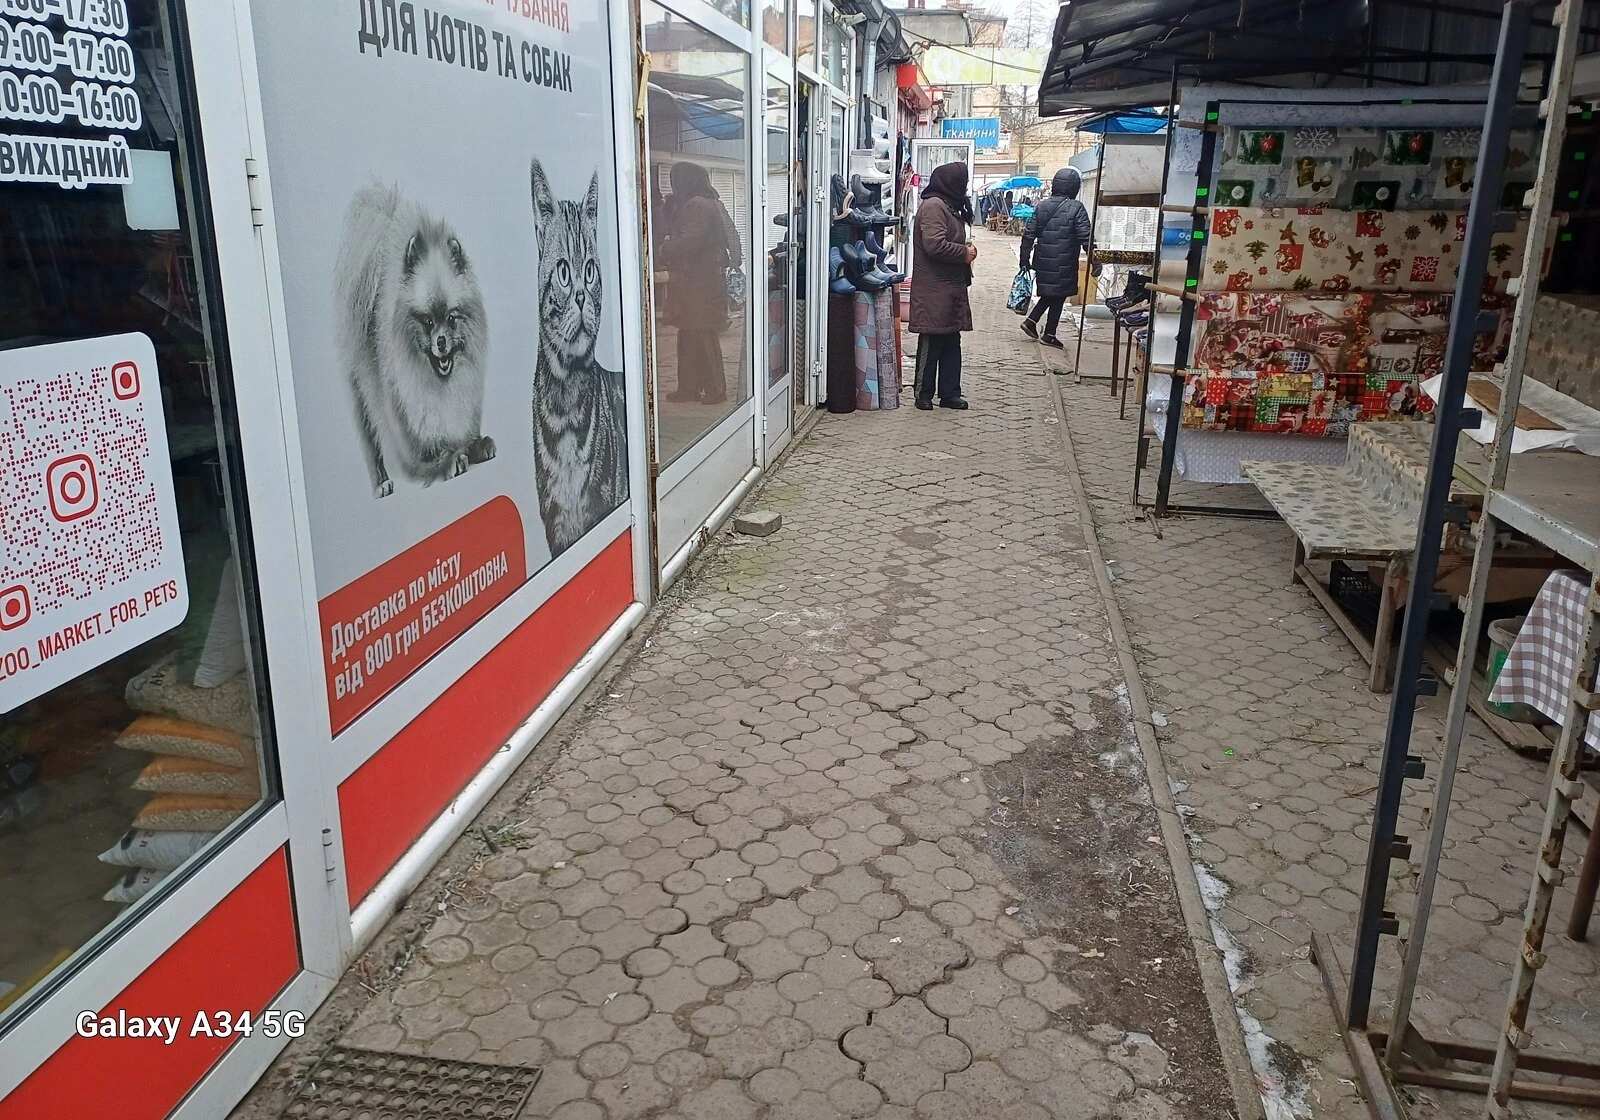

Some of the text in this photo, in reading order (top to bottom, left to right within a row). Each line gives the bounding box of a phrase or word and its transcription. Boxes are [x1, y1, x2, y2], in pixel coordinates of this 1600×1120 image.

[358, 0, 573, 93] ДЛЯ КОТІВ ТА СОБАК
[0, 78, 138, 124] 0:00-16:00
[945, 128, 996, 138] ТКАНИНИ
[0, 141, 130, 182] ВИХІДНИЙ
[331, 552, 461, 664] Доставка по місту
[334, 550, 509, 700] від 800 грн БЕЗКОШТОВНА
